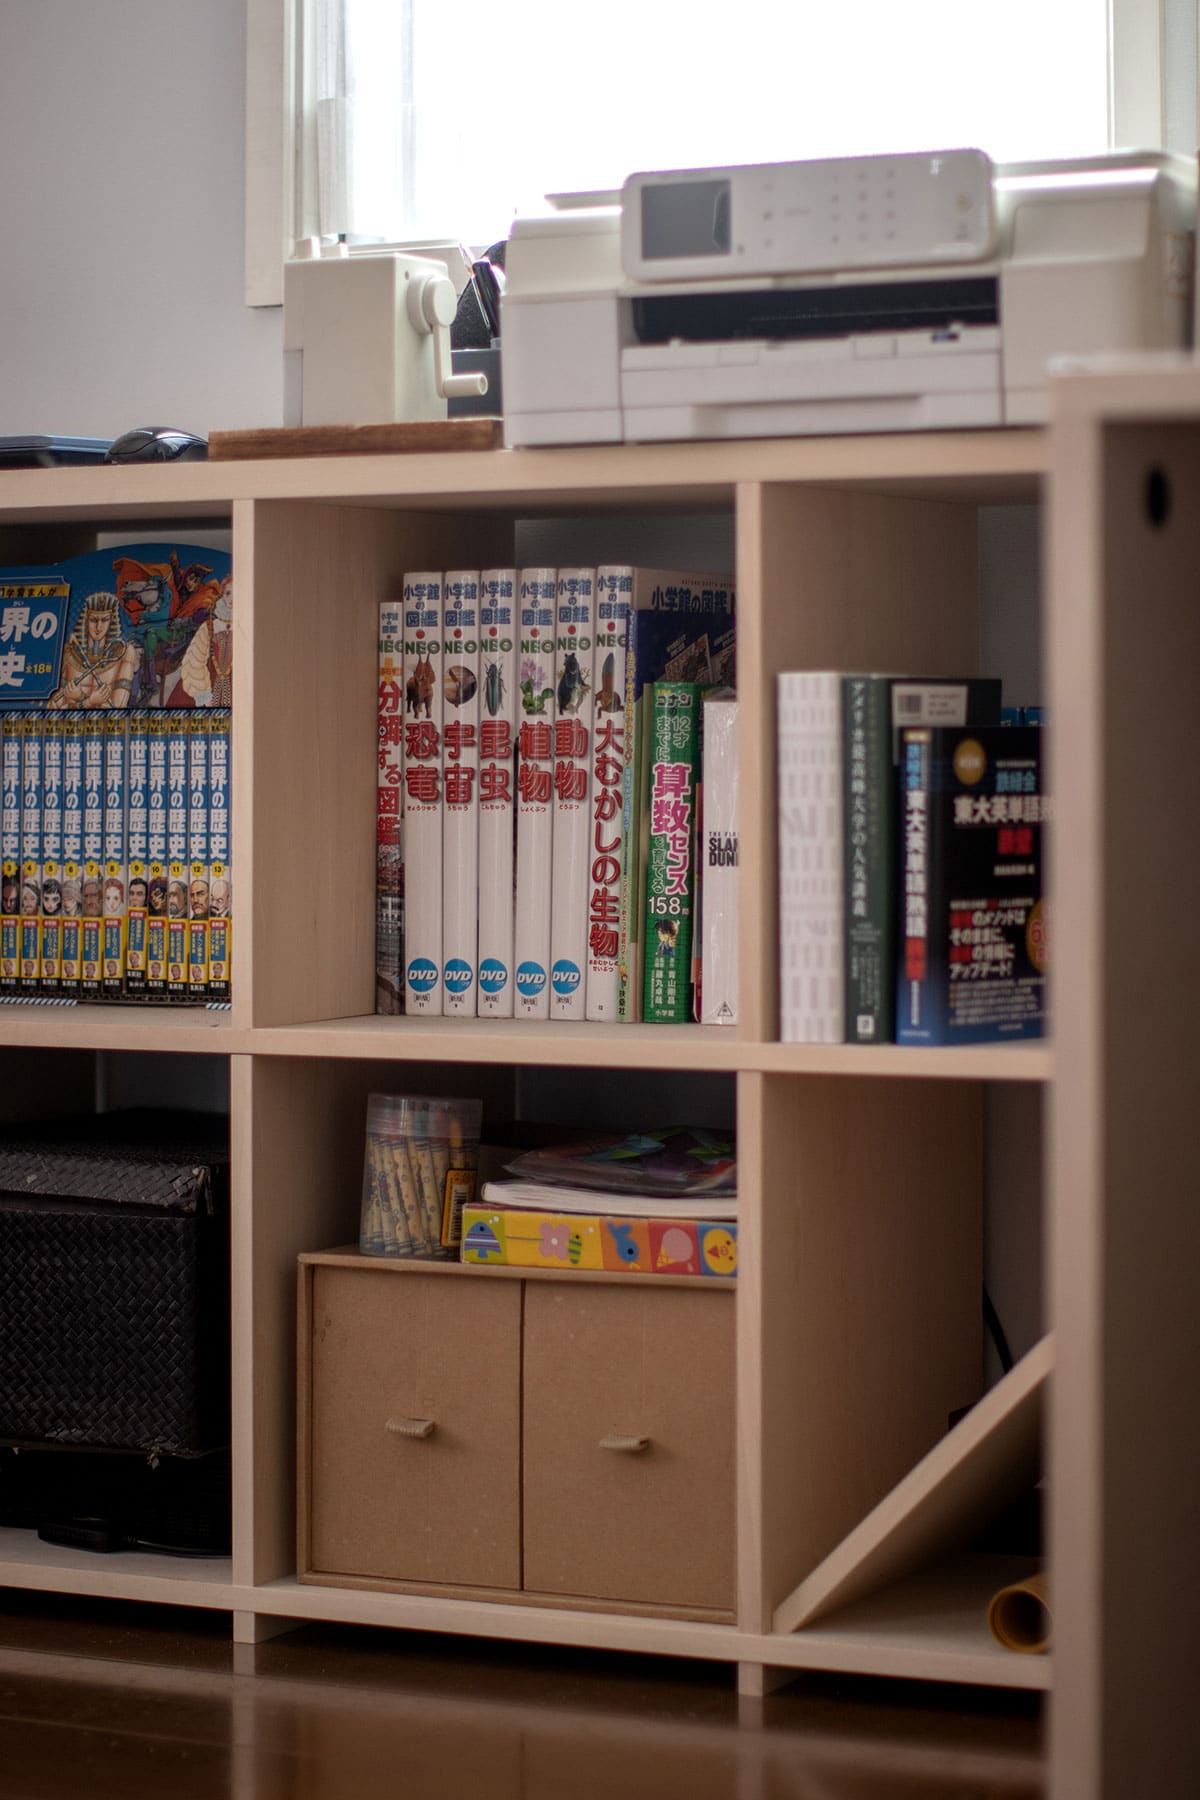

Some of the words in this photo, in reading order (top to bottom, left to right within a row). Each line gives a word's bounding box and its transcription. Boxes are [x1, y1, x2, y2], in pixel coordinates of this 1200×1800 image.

[404, 583, 440, 600] 小学館
[445, 583, 477, 600] 小学館
[480, 581, 513, 598] 小学館
[521, 582, 555, 600] 小学館
[558, 578, 592, 596] 小学館
[599, 575, 632, 592] 小学館
[416, 601, 425, 610] の
[453, 601, 462, 610] の
[489, 599, 498, 608] の
[531, 600, 540, 608] の
[568, 596, 577, 605] の
[608, 594, 617, 602] の
[406, 610, 438, 627] 図鑑
[445, 609, 475, 626] 図鑑
[481, 608, 511, 625] 図鑑
[522, 608, 552, 625] 図鑑
[559, 606, 589, 623] 図鑑
[0, 607, 58, 642] 界の
[405, 641, 440, 655] NEO
[444, 641, 477, 655] NEO
[480, 638, 513, 653] NEO
[520, 640, 553, 654] NEO
[557, 637, 591, 651] NEO
[0, 651, 26, 686] 史
[656, 695, 693, 708] コナン
[656, 716, 672, 762] までに
[673, 716, 691, 749] 12才
[405, 721, 440, 803] 恐竜
[444, 720, 476, 804] 宇宙
[479, 720, 511, 802] 昆虫
[518, 720, 553, 803] 植物
[554, 719, 588, 802] 動物
[4, 742, 19, 859] 世界の歴史
[24, 742, 40, 859] 世界の歴史
[45, 742, 61, 859] 世界の歴史
[64, 743, 82, 860] 世界の歴史
[85, 741, 102, 859] 世界の歴史
[106, 741, 123, 859] 世界の歴史
[130, 741, 147, 858] 世界の歴史
[150, 742, 167, 860] 世界の歴史
[170, 741, 186, 859] 世界の歴史
[190, 741, 207, 859] 世界の歴史
[210, 740, 228, 859] 世界の歴史
[589, 720, 624, 958] 大むかしの生物
[709, 852, 738, 867] DUN
[409, 970, 437, 980] DVD
[445, 970, 471, 980] DVD
[480, 970, 506, 980] DVD
[517, 974, 546, 983] DVD
[552, 971, 579, 981] DVD
